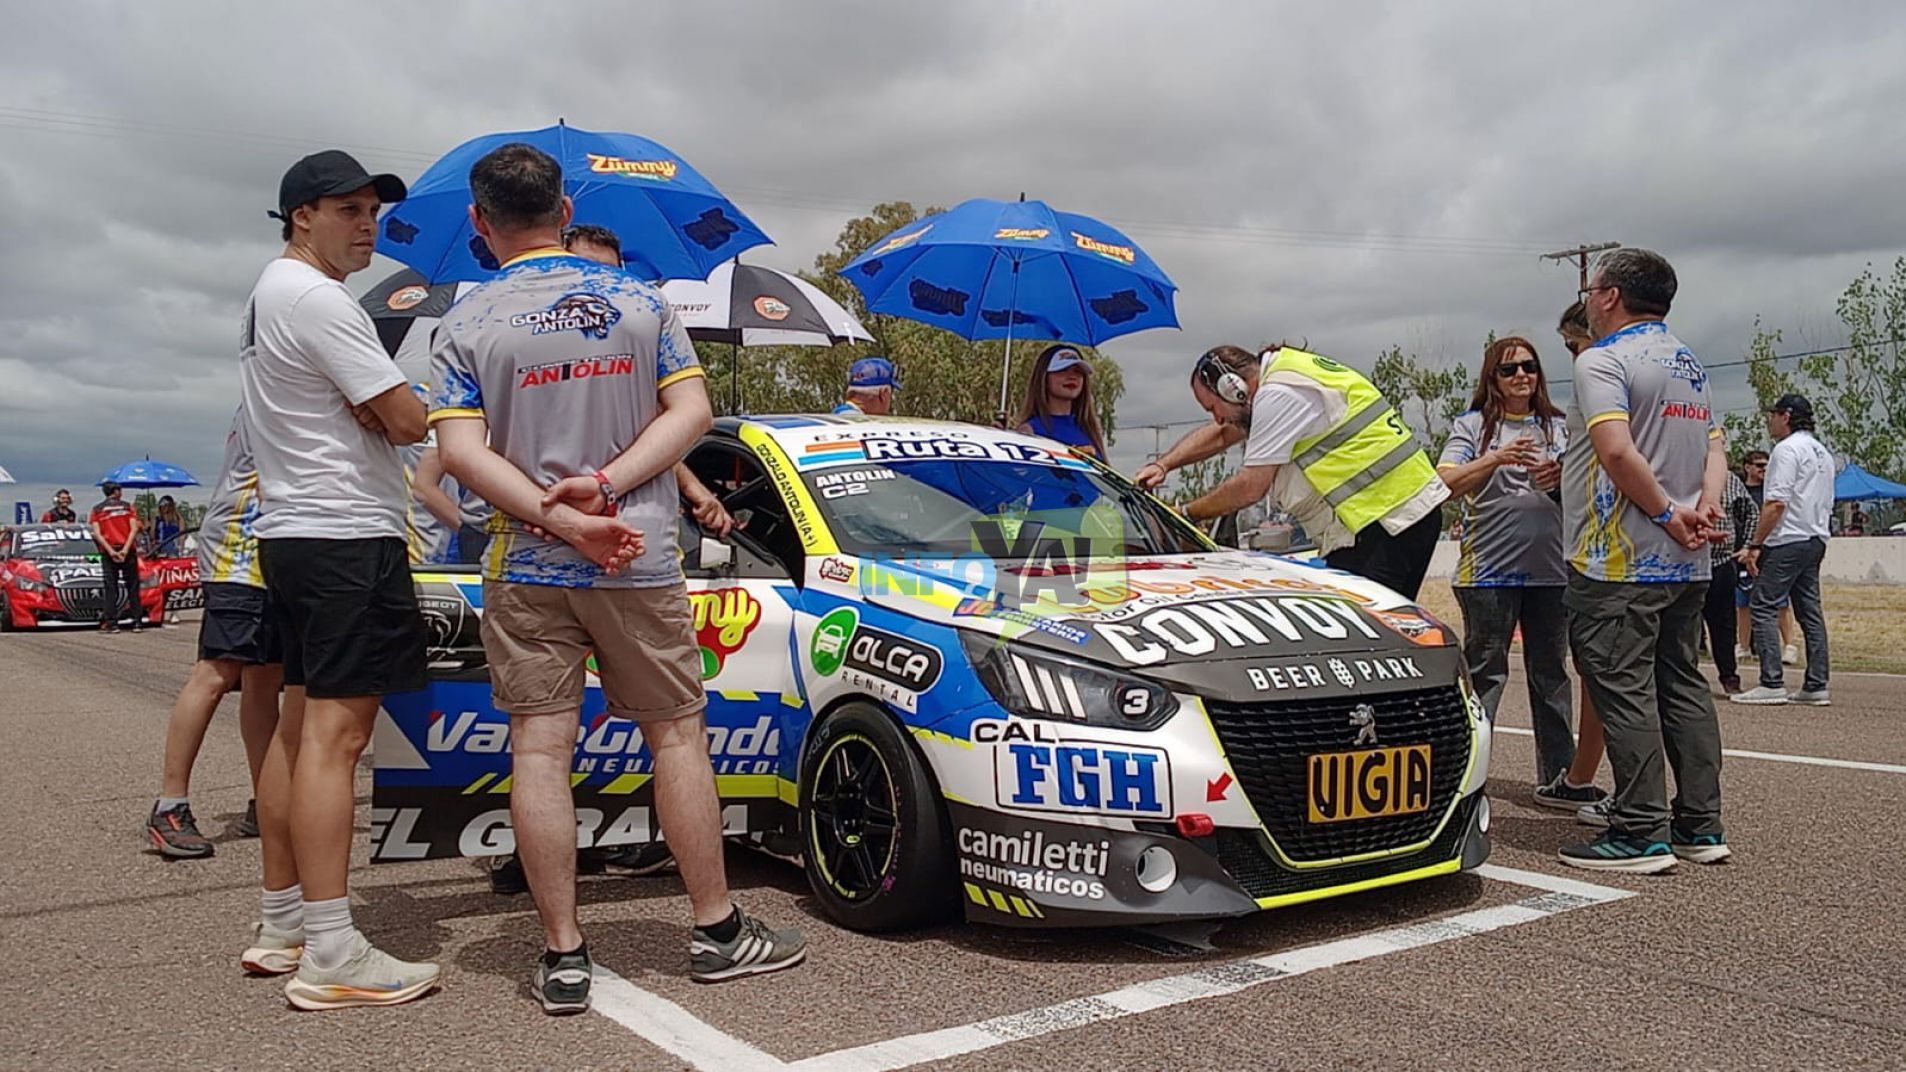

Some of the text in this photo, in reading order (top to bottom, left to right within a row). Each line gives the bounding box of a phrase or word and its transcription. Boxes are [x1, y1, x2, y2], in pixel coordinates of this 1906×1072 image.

[512, 307, 583, 326] GONZA
[533, 315, 601, 335] ANTOLIN
[814, 431, 968, 442] EXPRESO
[863, 439, 1056, 464] Ruta 12
[816, 469, 896, 487] ANTOLIN
[822, 483, 869, 499] C2
[419, 600, 458, 609] GEOT
[1093, 597, 1382, 667] CONVOY
[1247, 656, 1424, 692] BEER PARK
[841, 670, 914, 708] RENTAL
[1123, 688, 1150, 715] 3
[974, 721, 1058, 744] CAL
[1009, 743, 1163, 813] FGH
[957, 825, 1109, 877] camiletti
[959, 858, 1104, 902] neumaticos
